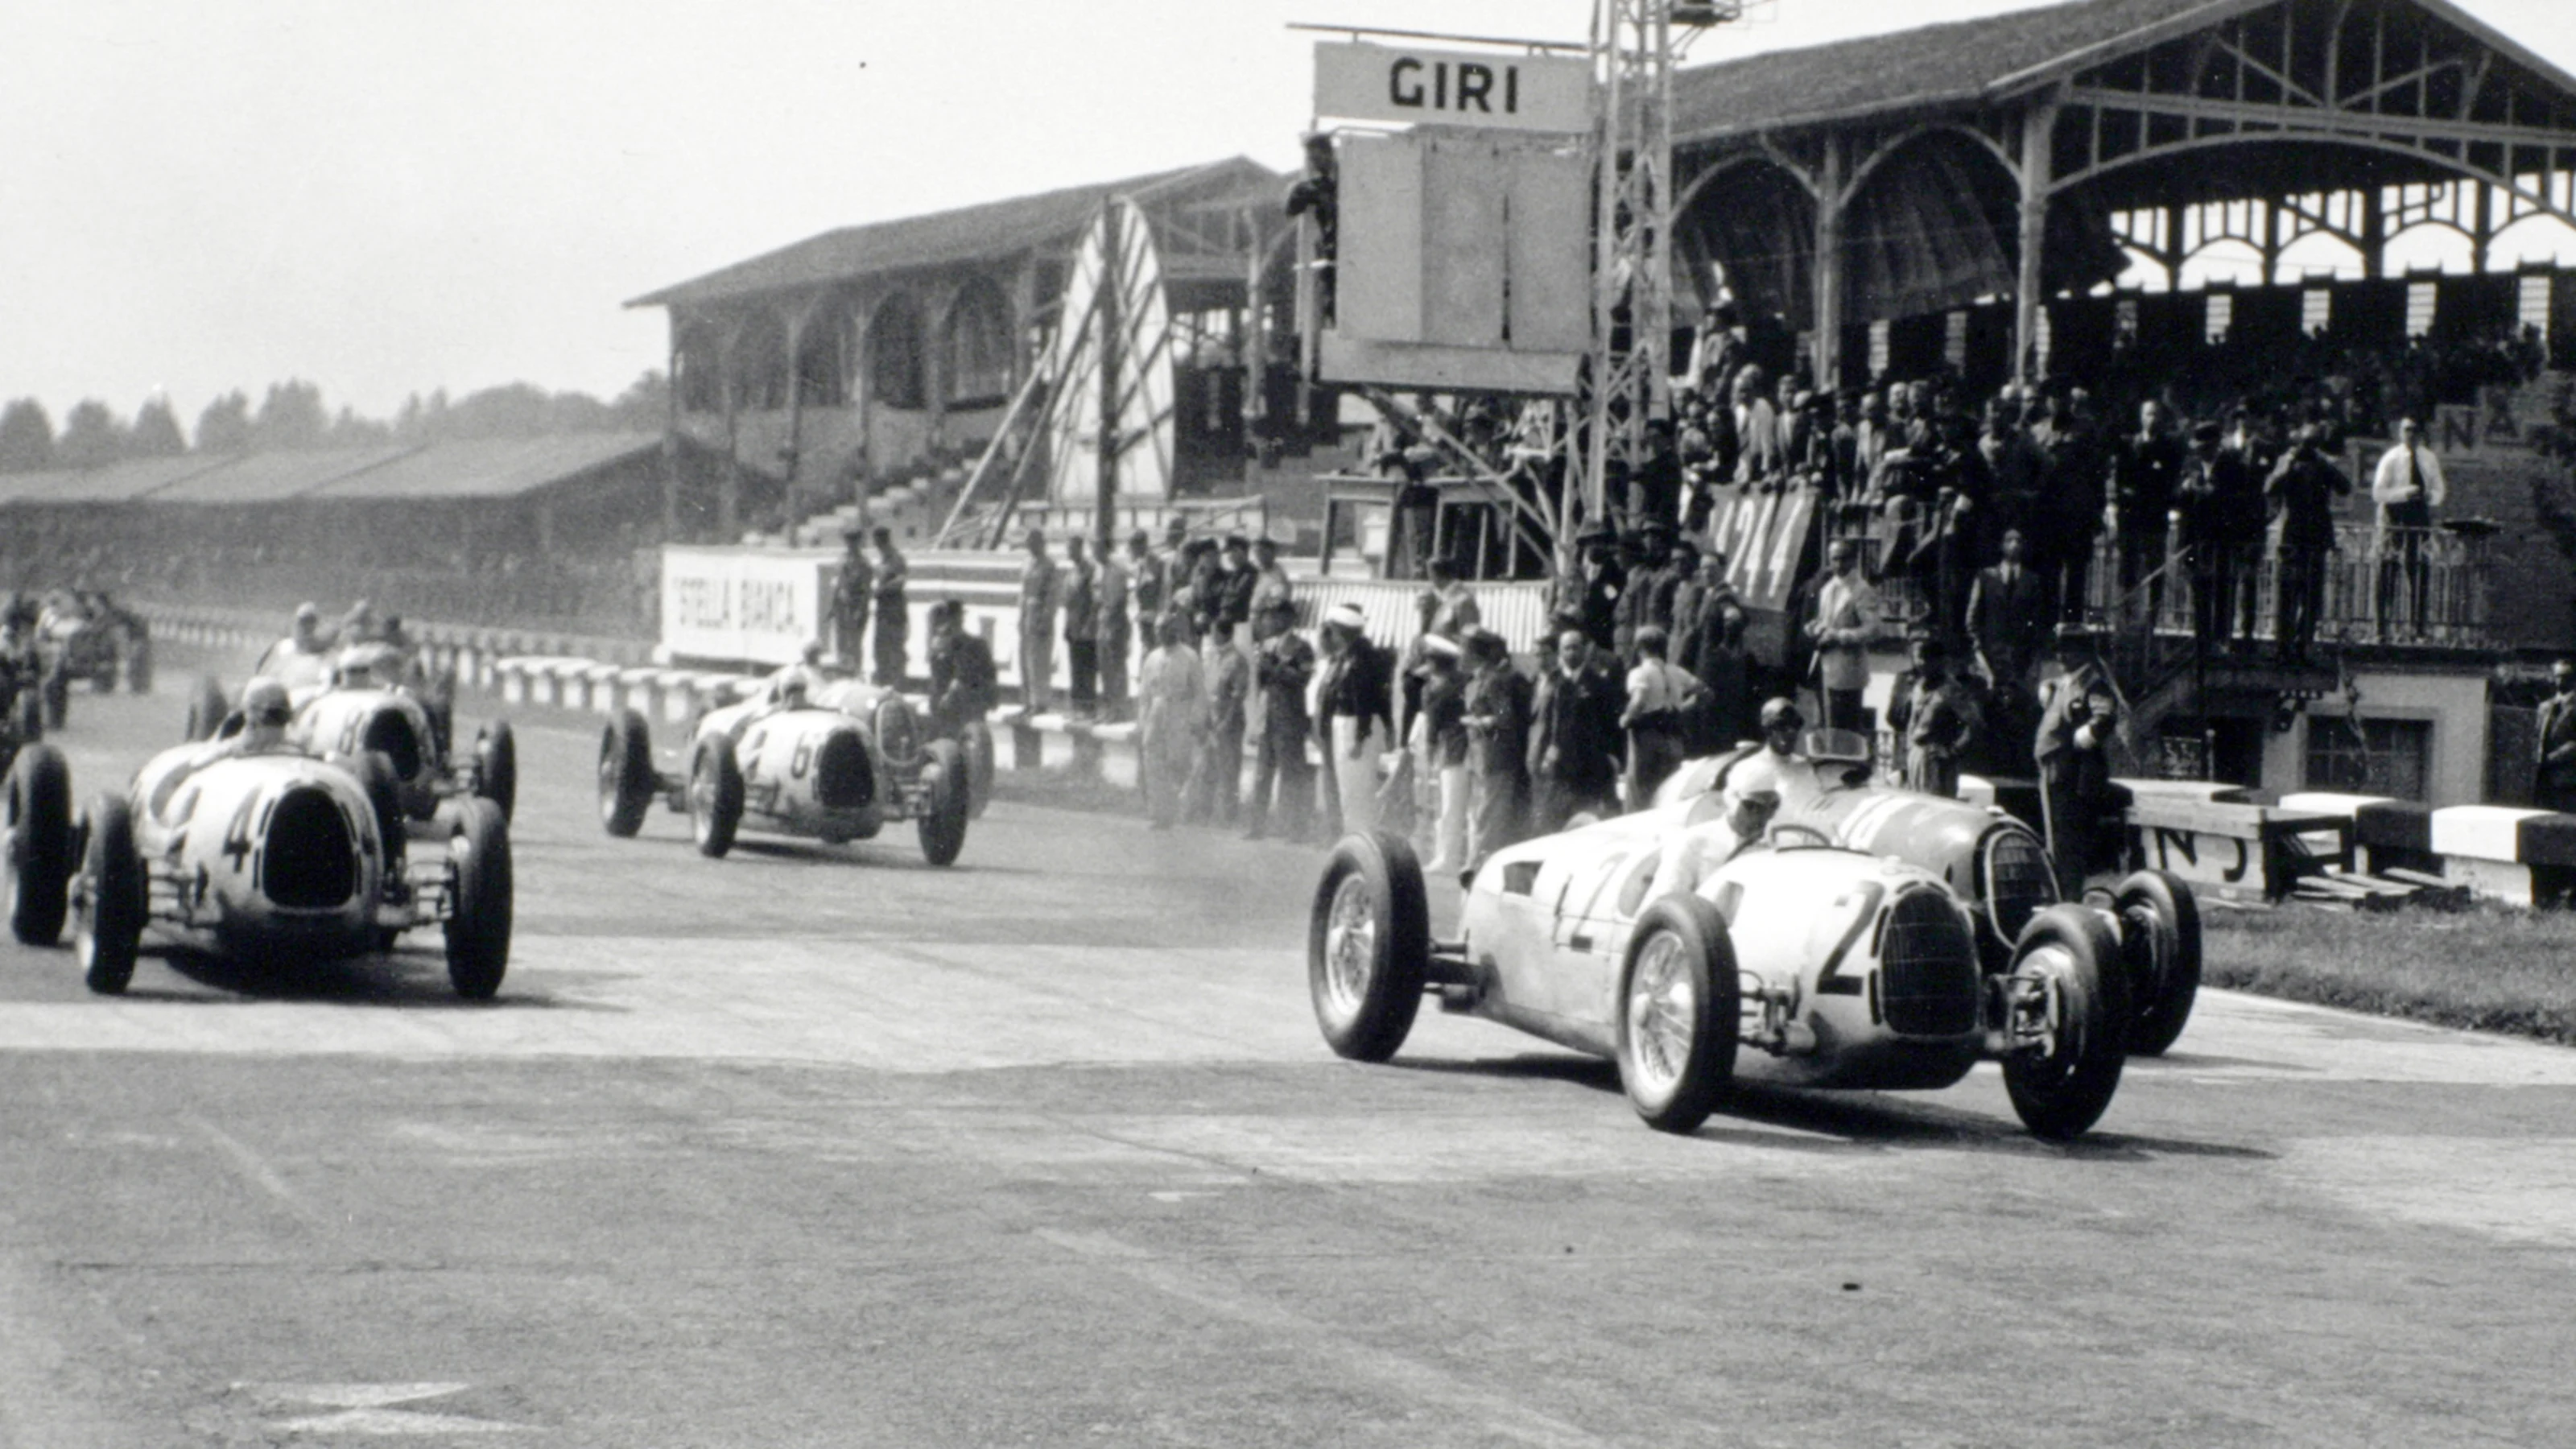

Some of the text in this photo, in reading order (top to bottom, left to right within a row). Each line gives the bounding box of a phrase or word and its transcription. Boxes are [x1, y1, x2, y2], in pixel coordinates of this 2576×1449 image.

[1389, 56, 1520, 114] GIRI
[790, 730, 817, 781] 6
[221, 784, 252, 876] 4
[1815, 880, 1886, 996] 2
